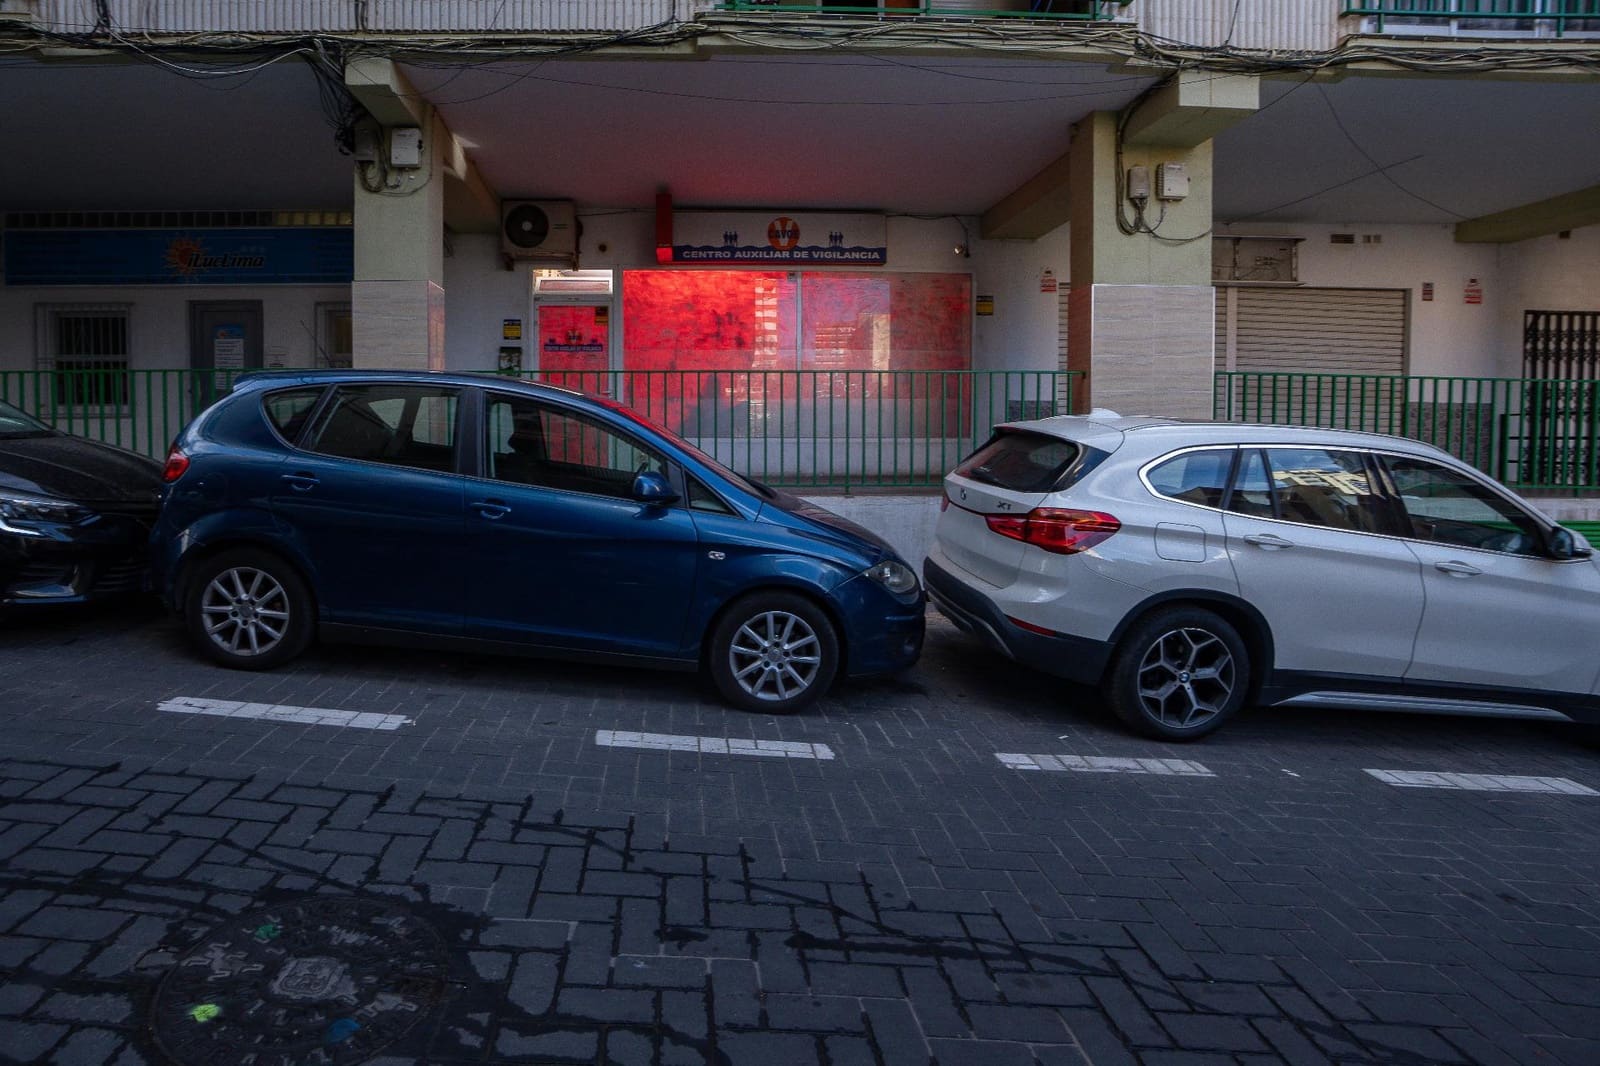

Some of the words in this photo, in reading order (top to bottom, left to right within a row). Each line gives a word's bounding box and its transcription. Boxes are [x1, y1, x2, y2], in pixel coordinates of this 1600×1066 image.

[682, 250, 730, 258] CENTRO
[734, 250, 791, 258] AUXILIAR
[793, 250, 809, 258] DE
[812, 250, 880, 259] VIGILANCIA
